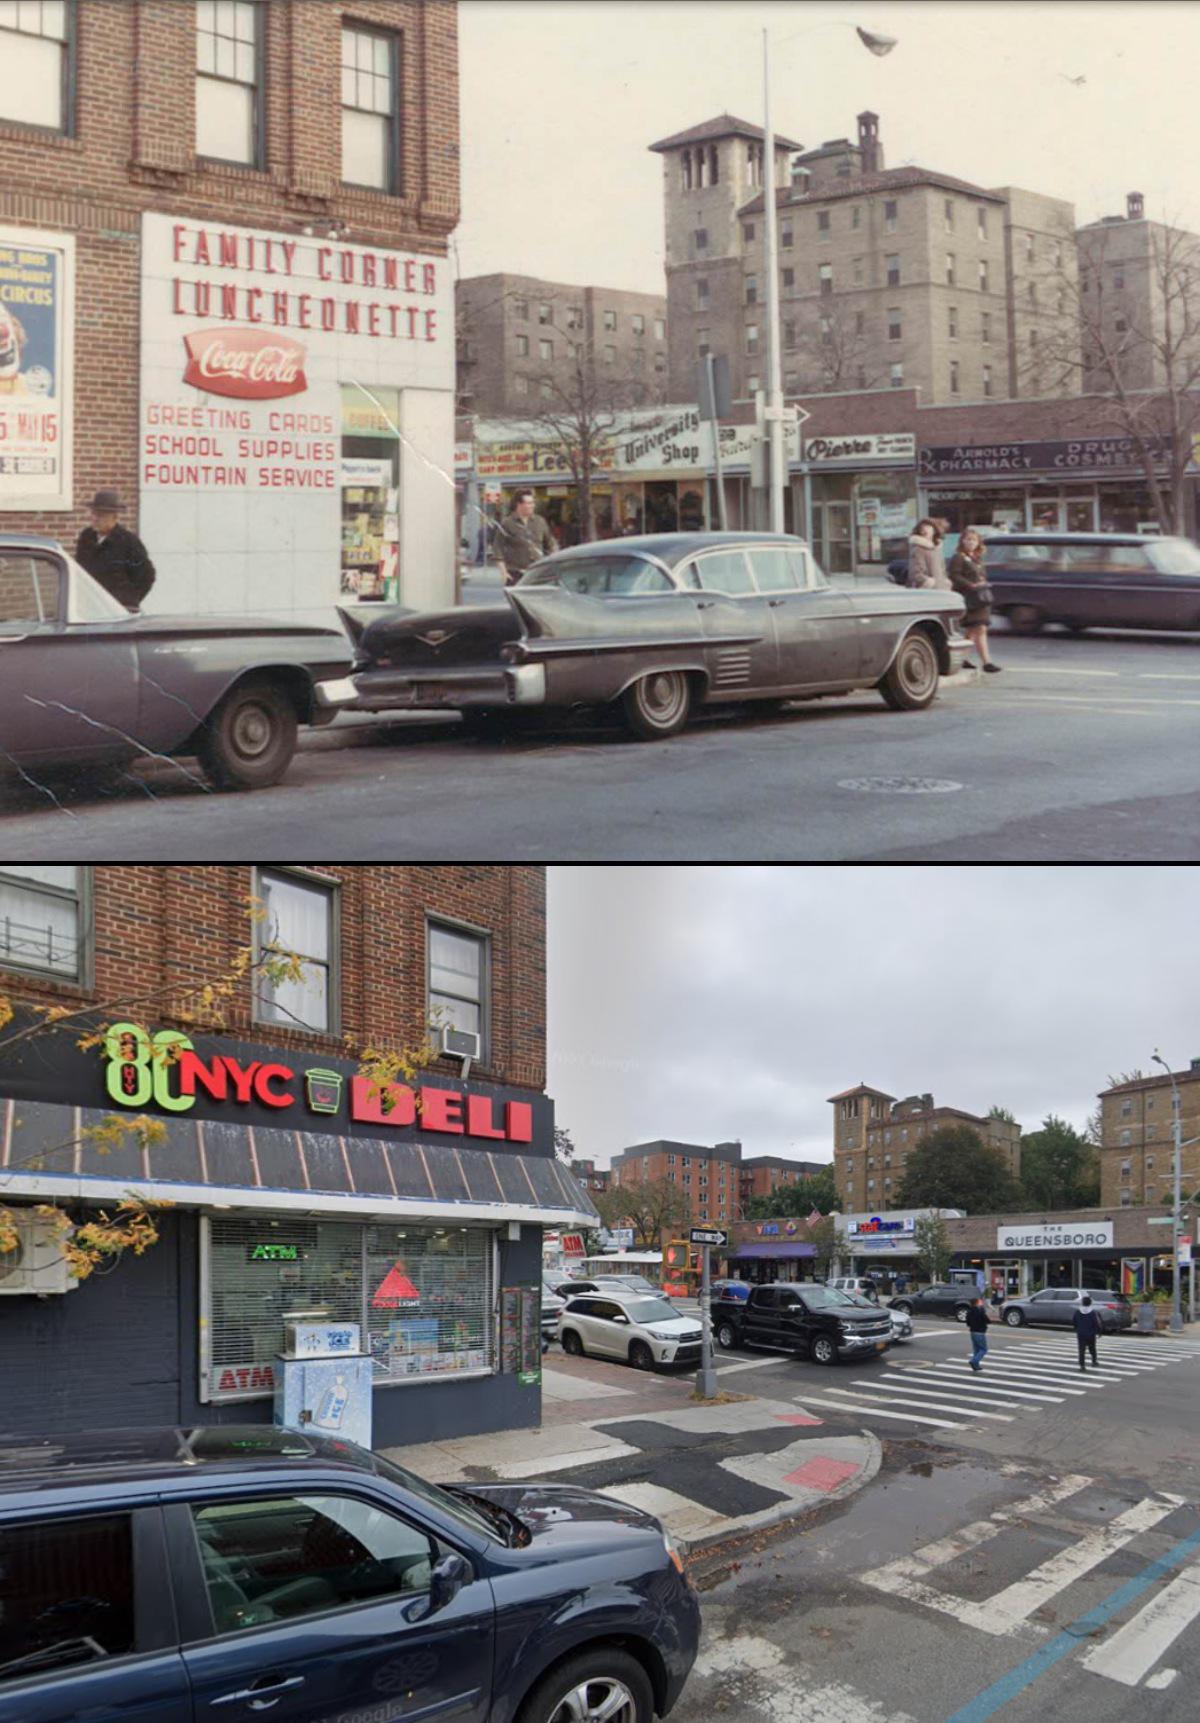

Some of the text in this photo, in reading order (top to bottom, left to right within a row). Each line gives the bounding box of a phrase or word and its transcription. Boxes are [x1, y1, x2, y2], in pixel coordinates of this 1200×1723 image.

[173, 224, 436, 296] FAMILY CORNER
[173, 277, 437, 341] LUNCHEONETTE
[199, 340, 298, 384] Coca-Cola
[41, 413, 58, 442] 15
[147, 404, 334, 434] GREETING CARDS
[145, 434, 335, 462] SCHOOL SUPPLIES
[625, 412, 699, 463] University
[807, 439, 872, 461] Pierre
[662, 443, 699, 465] Shop
[939, 457, 1032, 471] PHARMACY
[953, 447, 1020, 459] ARNOLD'S
[144, 463, 247, 486] FOUNTAIN
[258, 466, 335, 488] SERVICE
[180, 1049, 296, 1108] NYC
[350, 1074, 533, 1143] DELI
[251, 1244, 298, 1260] ATM
[563, 1235, 583, 1251] ATM
[1004, 1233, 1107, 1247] QUEENSBORO
[218, 1367, 274, 1390] ATM
